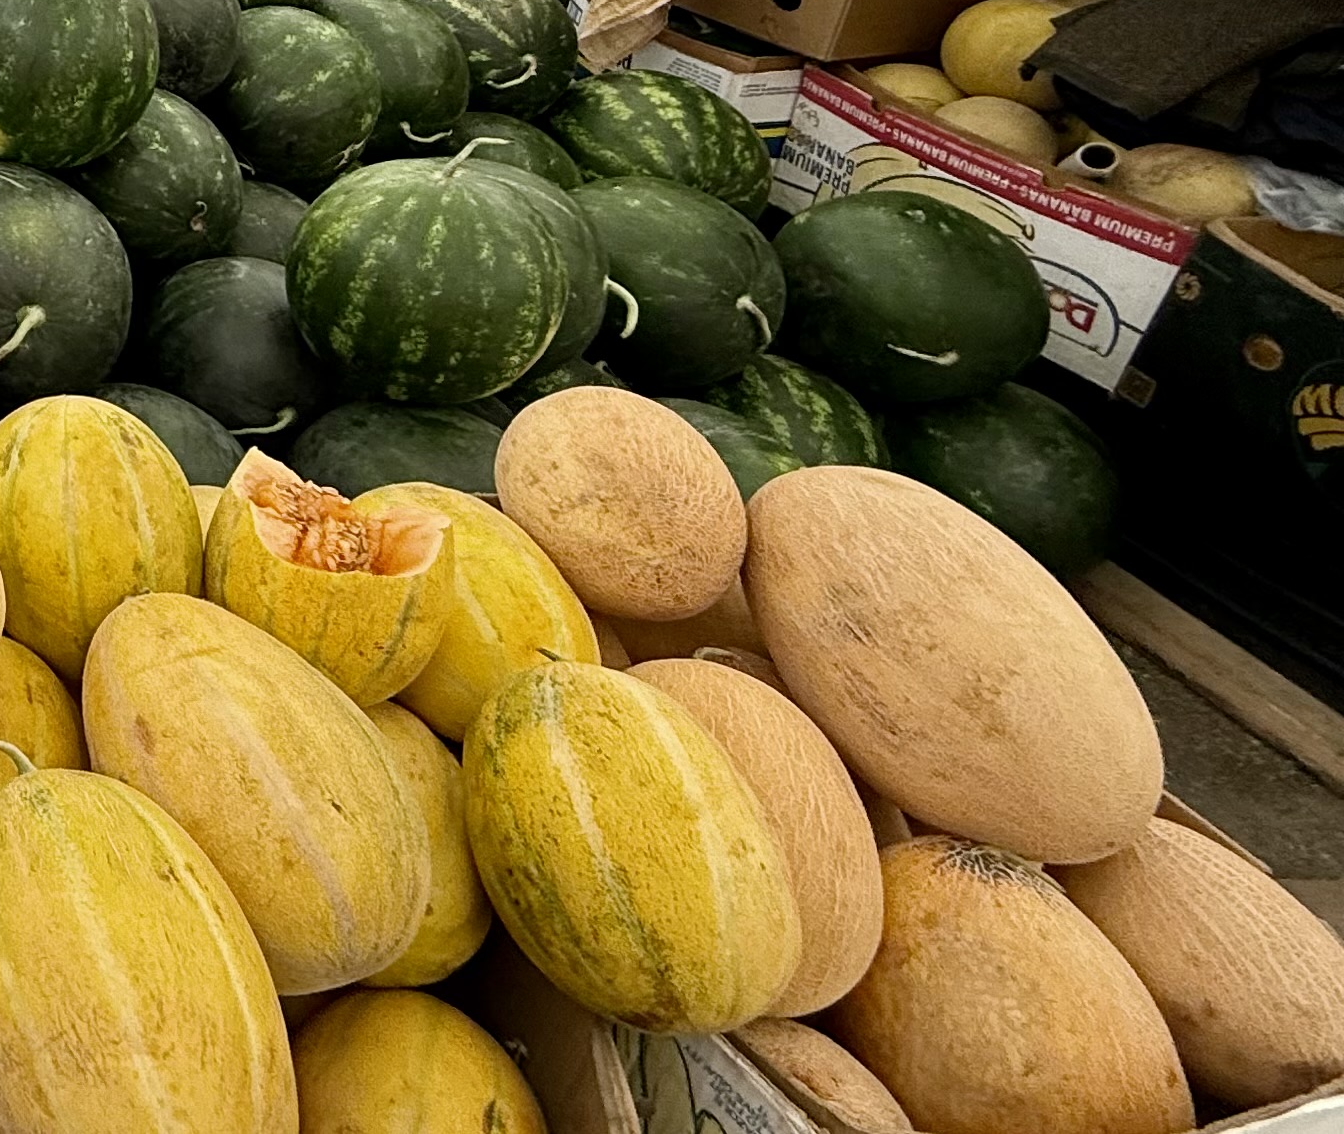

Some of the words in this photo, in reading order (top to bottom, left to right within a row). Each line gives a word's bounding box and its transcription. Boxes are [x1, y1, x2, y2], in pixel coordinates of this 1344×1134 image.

[802, 76, 843, 109] BANANAS
[839, 101, 887, 134] PREMIUM
[891, 128, 948, 162] BANANAS
[781, 144, 850, 196] PREMIUM
[948, 155, 1010, 190] PREMIUM
[1020, 185, 1093, 219] BANANAS
[1094, 214, 1177, 254] PREMIUM
